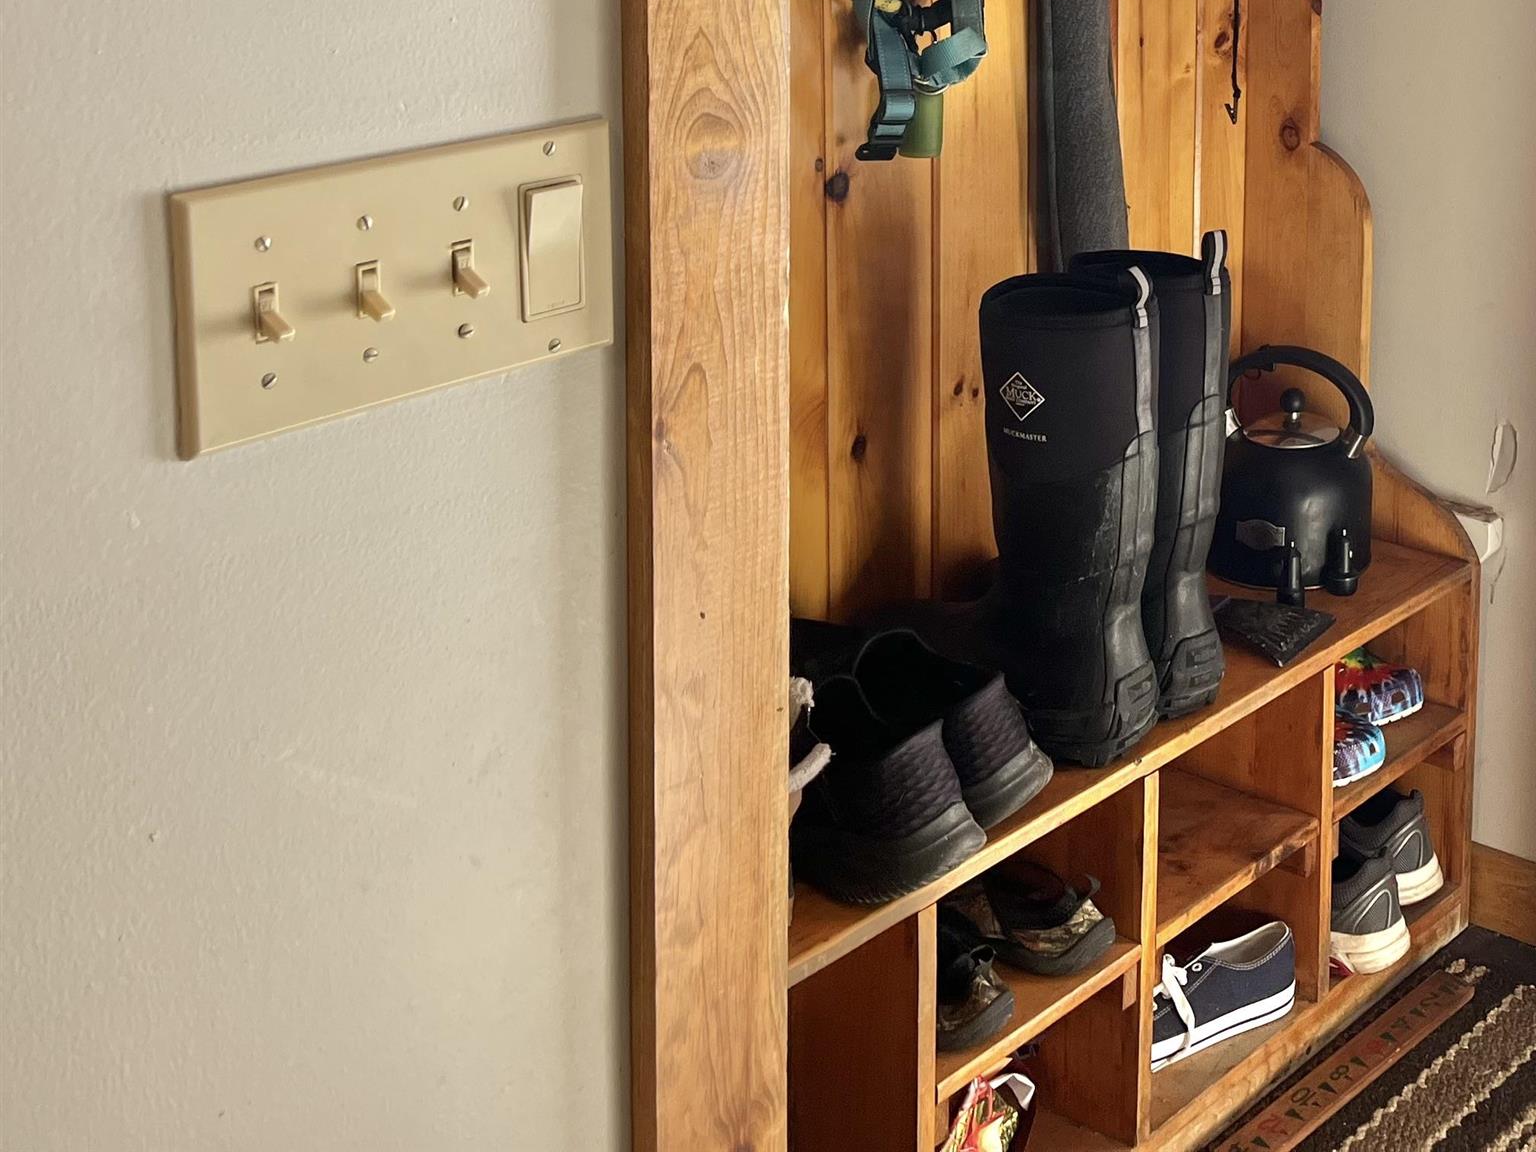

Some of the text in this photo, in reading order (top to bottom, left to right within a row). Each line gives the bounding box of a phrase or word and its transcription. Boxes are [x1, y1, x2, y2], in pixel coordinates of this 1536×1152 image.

[1005, 385, 1036, 401] MUCK
[1329, 1064, 1350, 1081] 8
[1291, 1087, 1317, 1107] 10
